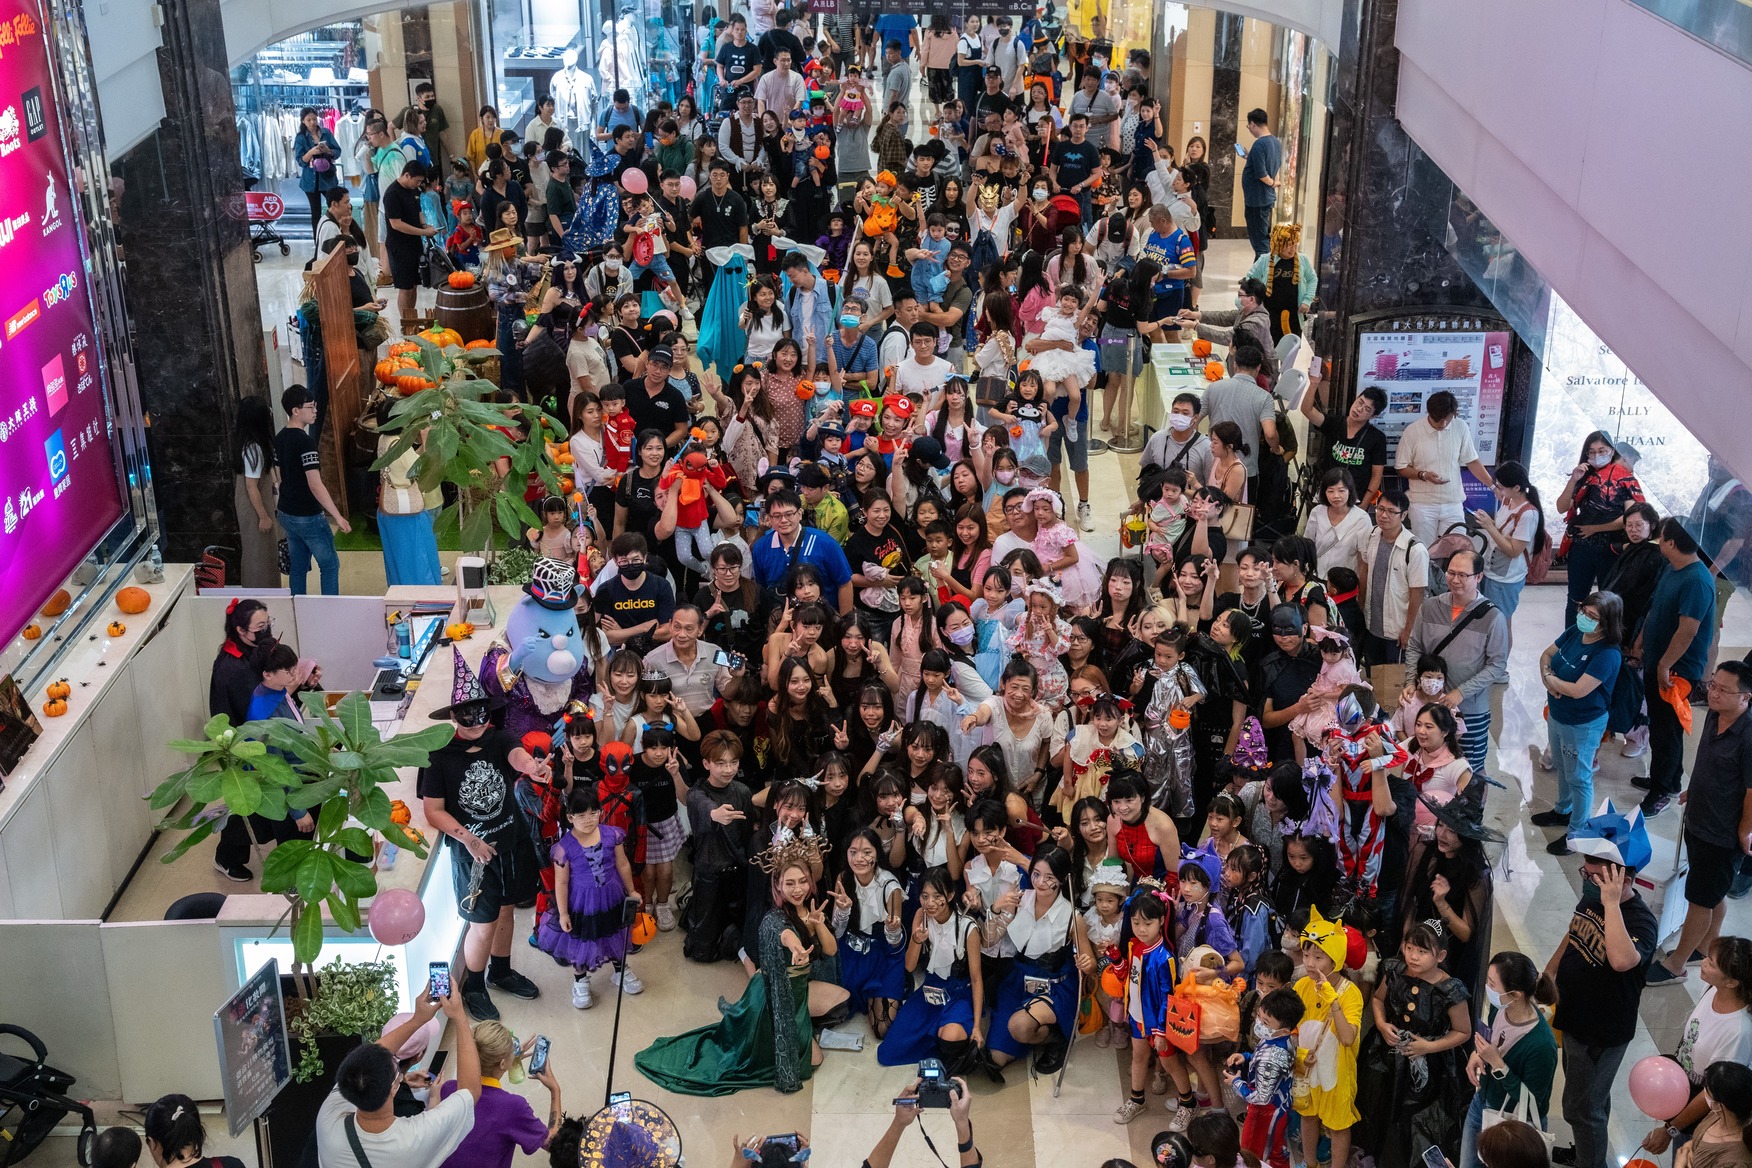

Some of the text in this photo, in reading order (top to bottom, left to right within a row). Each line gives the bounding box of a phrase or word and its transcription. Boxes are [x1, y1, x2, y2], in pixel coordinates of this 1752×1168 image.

[26, 95, 42, 127] GAP
[43, 219, 63, 237] KANGOL
[1566, 376, 1629, 386] Salvatore
[1608, 406, 1652, 416] BALLY
[1625, 437, 1666, 446] HAAN
[614, 598, 656, 611] adidas
